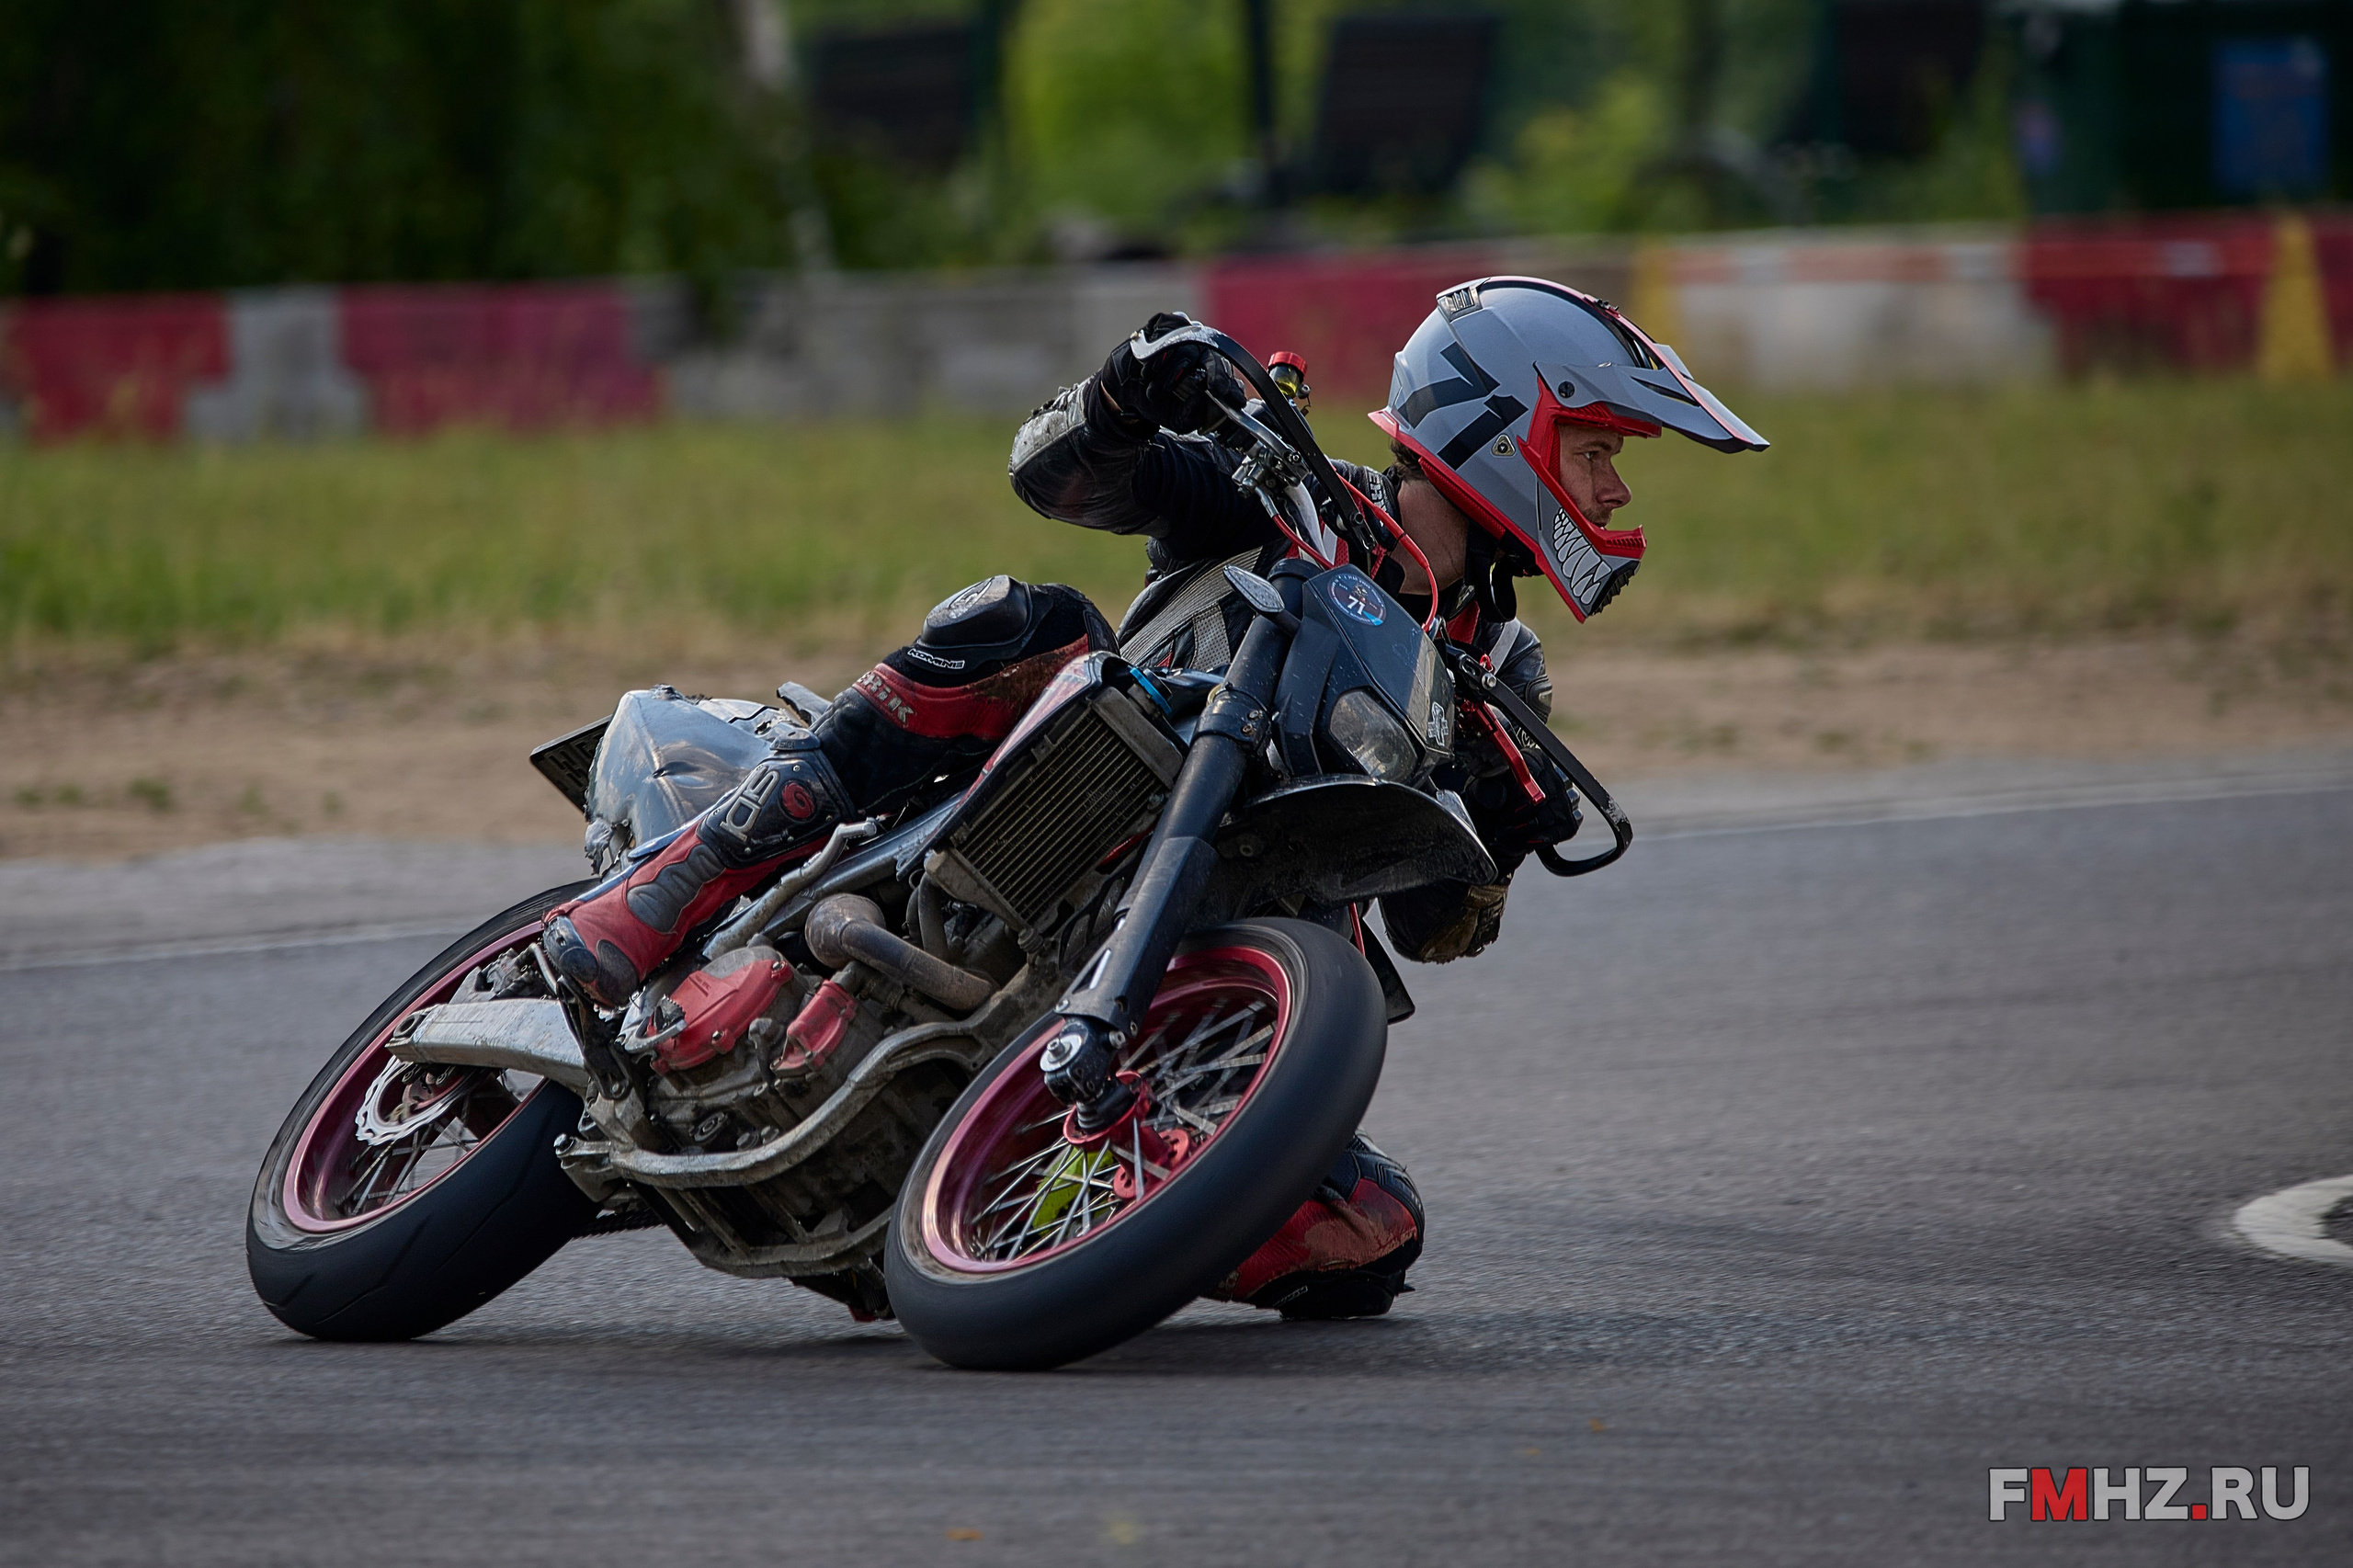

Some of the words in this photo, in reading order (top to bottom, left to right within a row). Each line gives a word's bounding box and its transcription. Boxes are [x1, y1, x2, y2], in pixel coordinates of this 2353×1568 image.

[1397, 341, 1529, 472] 71
[1347, 595, 1366, 616] 71
[907, 648, 965, 669] KOMINE
